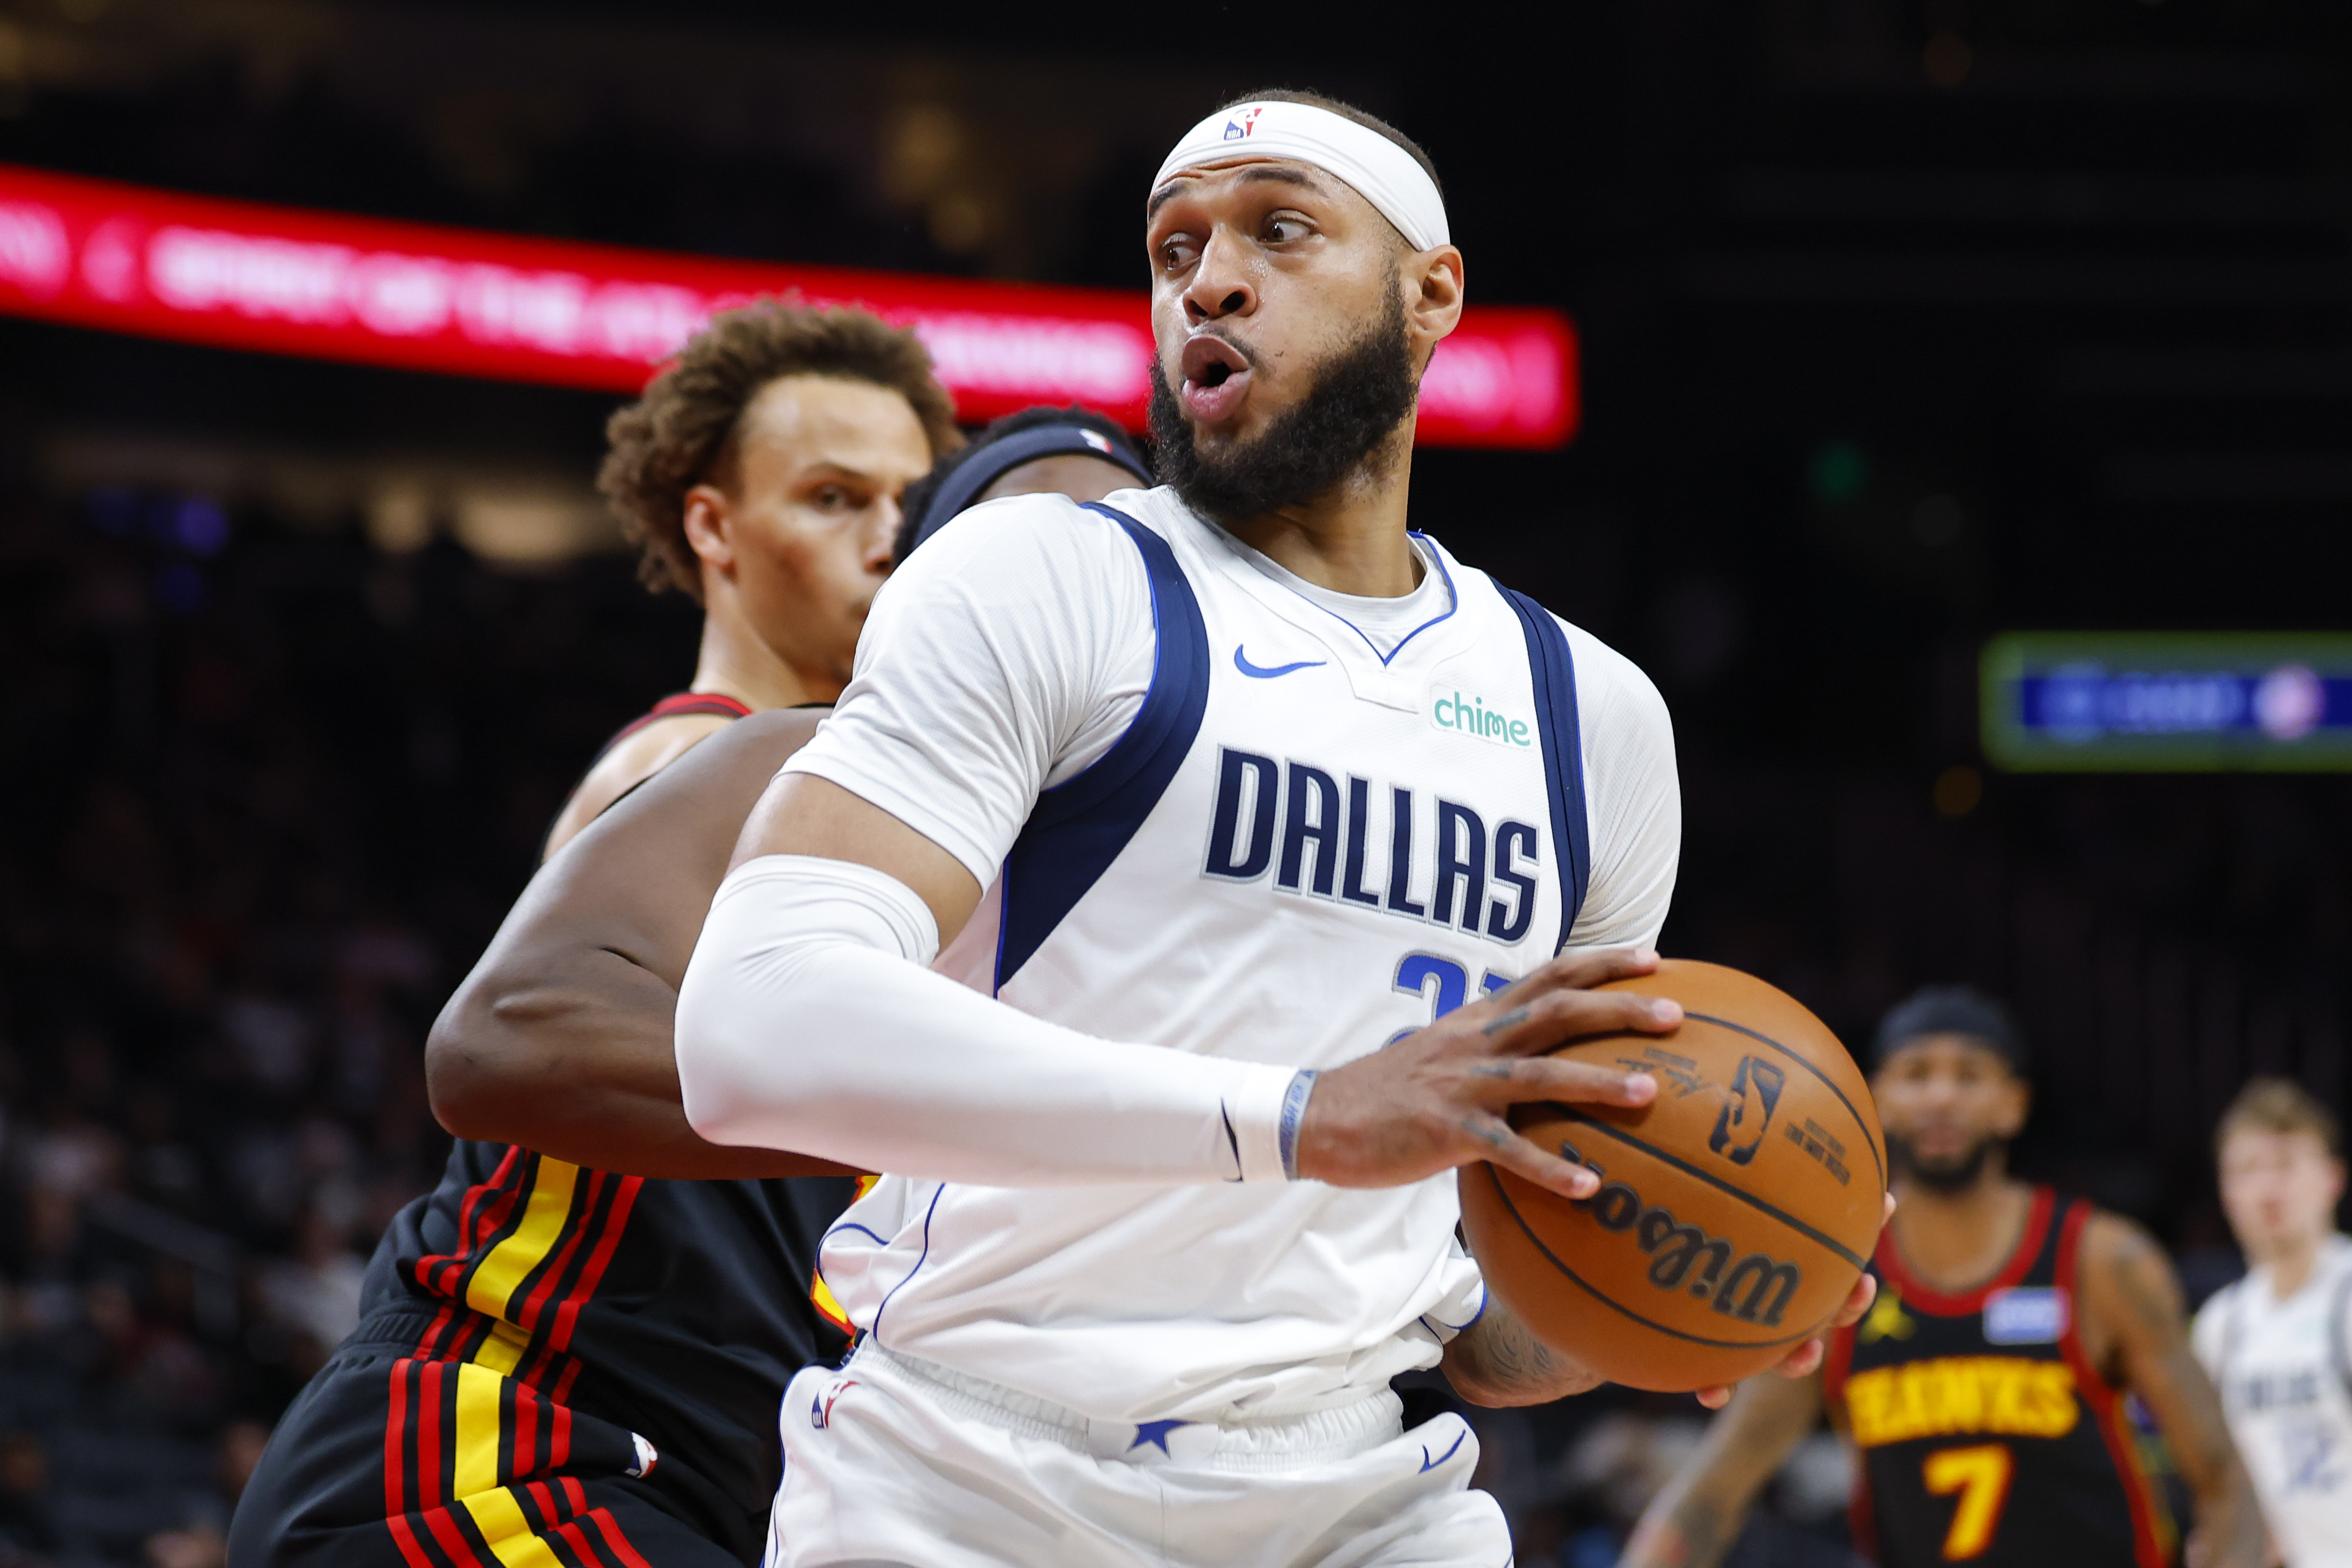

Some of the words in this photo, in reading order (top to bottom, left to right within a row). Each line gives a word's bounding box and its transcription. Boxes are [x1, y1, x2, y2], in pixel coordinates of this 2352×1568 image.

[1435, 691, 1530, 746] chime
[1199, 743, 1540, 947] DALLAS
[1381, 949, 1522, 1049] 2
[1922, 1442, 2016, 1562] 7
